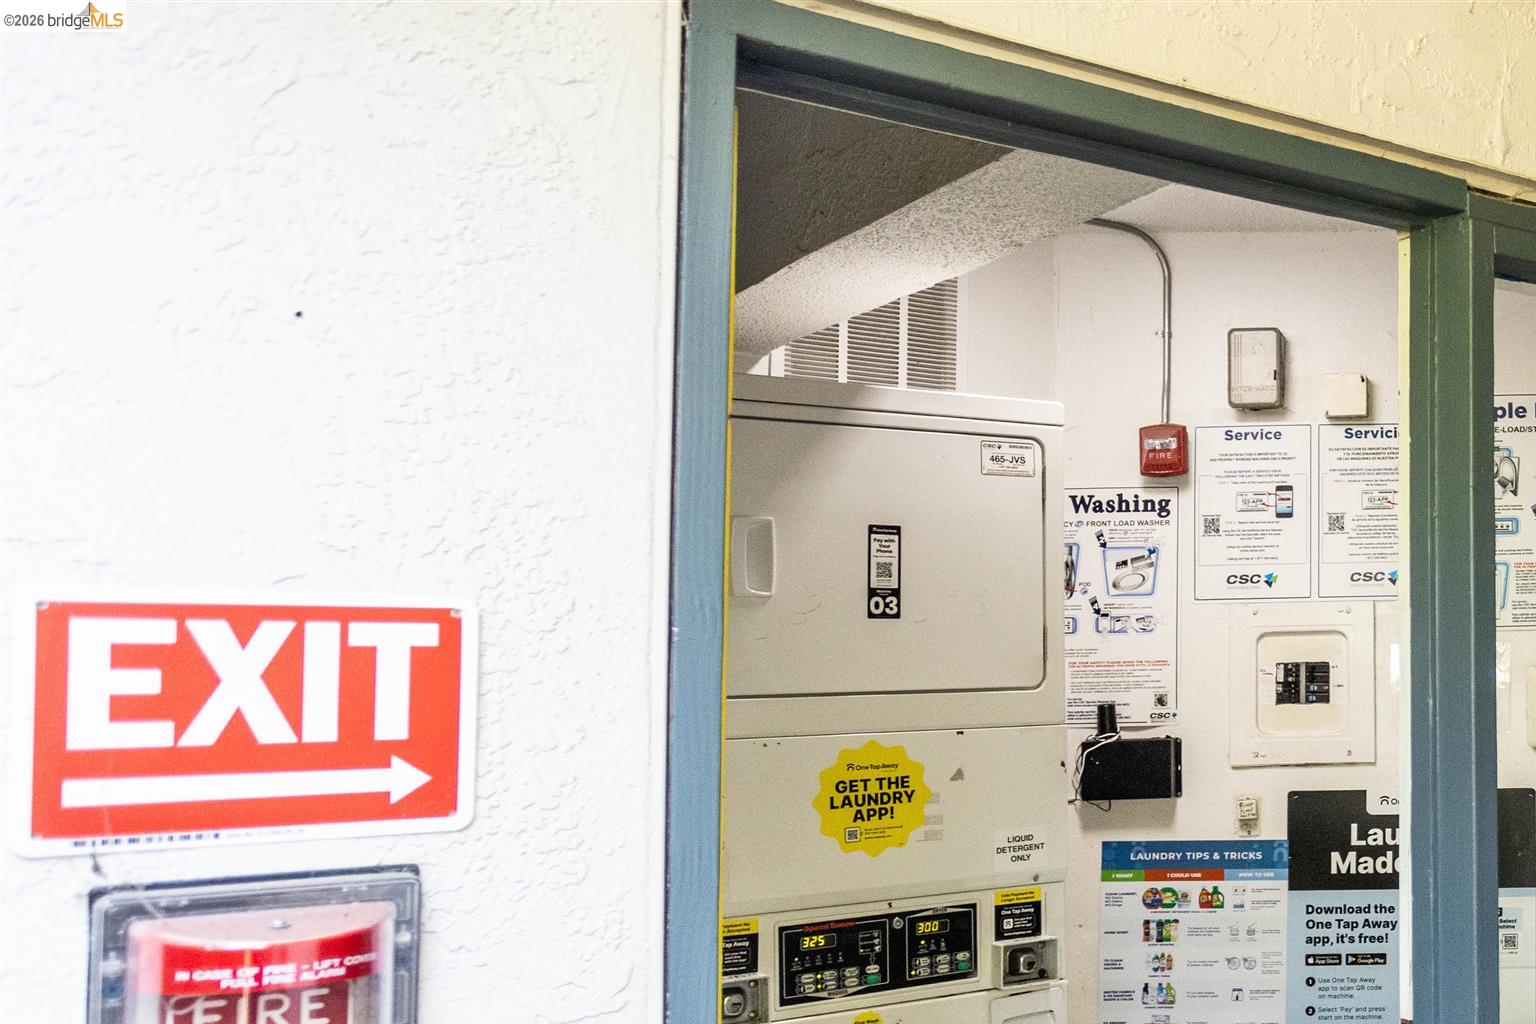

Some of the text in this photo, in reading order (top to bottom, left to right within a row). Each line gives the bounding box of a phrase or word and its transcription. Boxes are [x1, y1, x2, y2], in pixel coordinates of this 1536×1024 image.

[1224, 429, 1282, 440] Service
[1344, 427, 1399, 439] Servici
[990, 455, 1026, 464] 465-JVS
[1069, 493, 1171, 518] Washing
[1226, 574, 1261, 584] CSC
[1350, 572, 1385, 582] CSC
[870, 596, 898, 614] 03
[66, 615, 440, 751] EXIT
[835, 775, 910, 794] GET THE
[829, 790, 915, 810] LAUNDRY
[852, 806, 894, 822] APP!
[1007, 834, 1033, 843] LIQUID
[996, 843, 1045, 854] DETERGENT
[1011, 854, 1031, 862] ONLY
[1130, 851, 1263, 861] LAUNDRY TIPS & TRICKS
[1305, 904, 1395, 915] Download the
[918, 921, 939, 933] 300
[1306, 919, 1398, 931] One Tap Away
[802, 935, 825, 948] 325
[1305, 933, 1388, 947] app, it's free!
